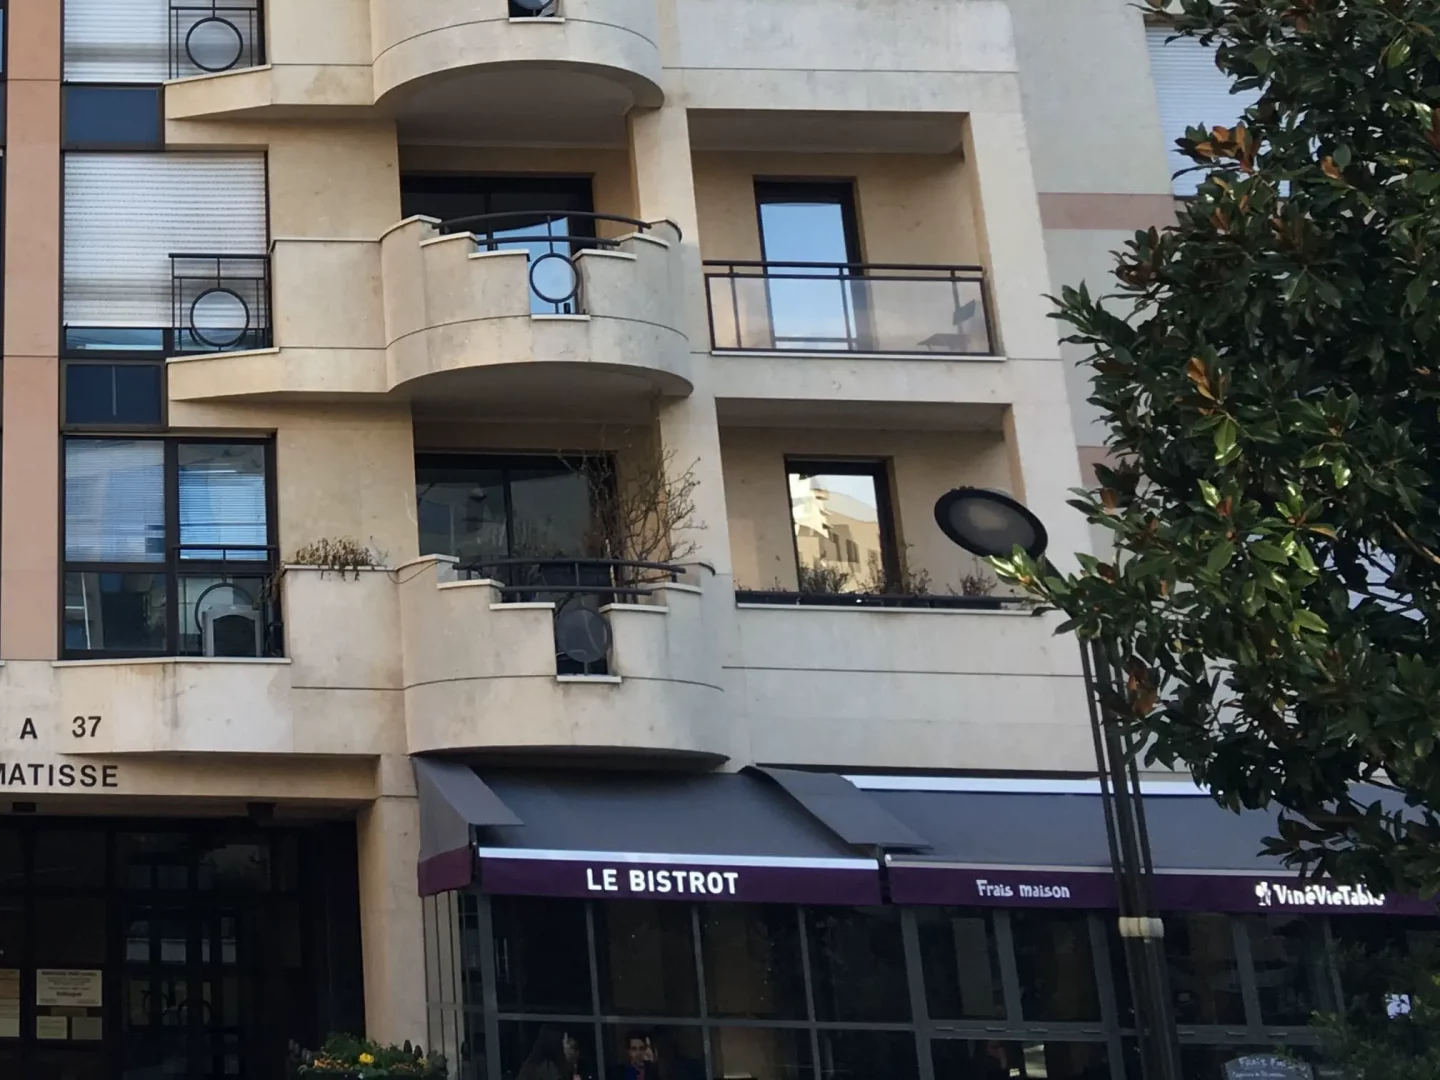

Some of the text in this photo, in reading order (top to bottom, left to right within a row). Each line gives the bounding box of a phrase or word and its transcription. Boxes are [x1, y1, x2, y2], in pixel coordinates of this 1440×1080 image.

[19, 718, 38, 740] A
[72, 716, 102, 738] 37
[586, 868, 739, 894] LE BISTROT
[976, 879, 1070, 898] Frais maison
